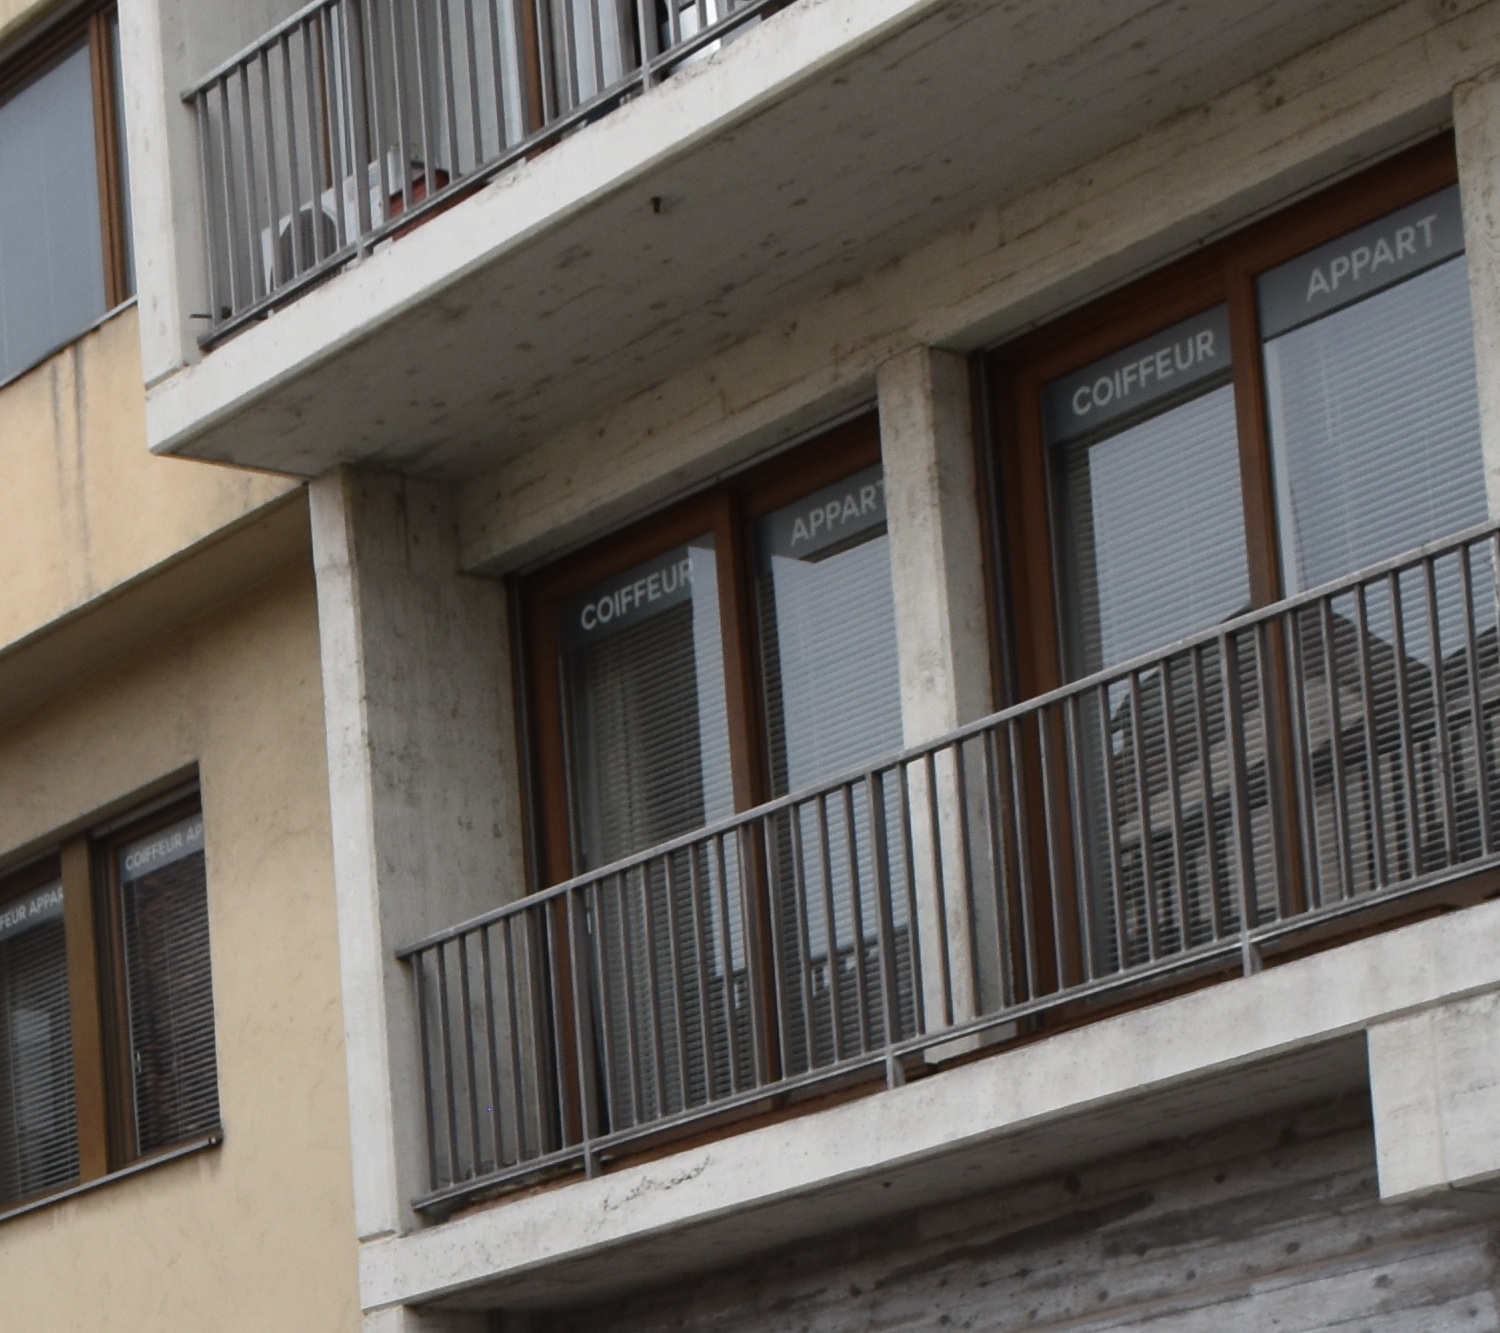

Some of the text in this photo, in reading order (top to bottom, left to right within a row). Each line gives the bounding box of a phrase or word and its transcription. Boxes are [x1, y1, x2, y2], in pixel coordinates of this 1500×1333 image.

[1072, 214, 1437, 416] COIFFEUR APPART
[581, 557, 694, 630] COIFFEUR
[125, 833, 182, 870] COIFFEUR
[28, 886, 64, 914] APPAR
